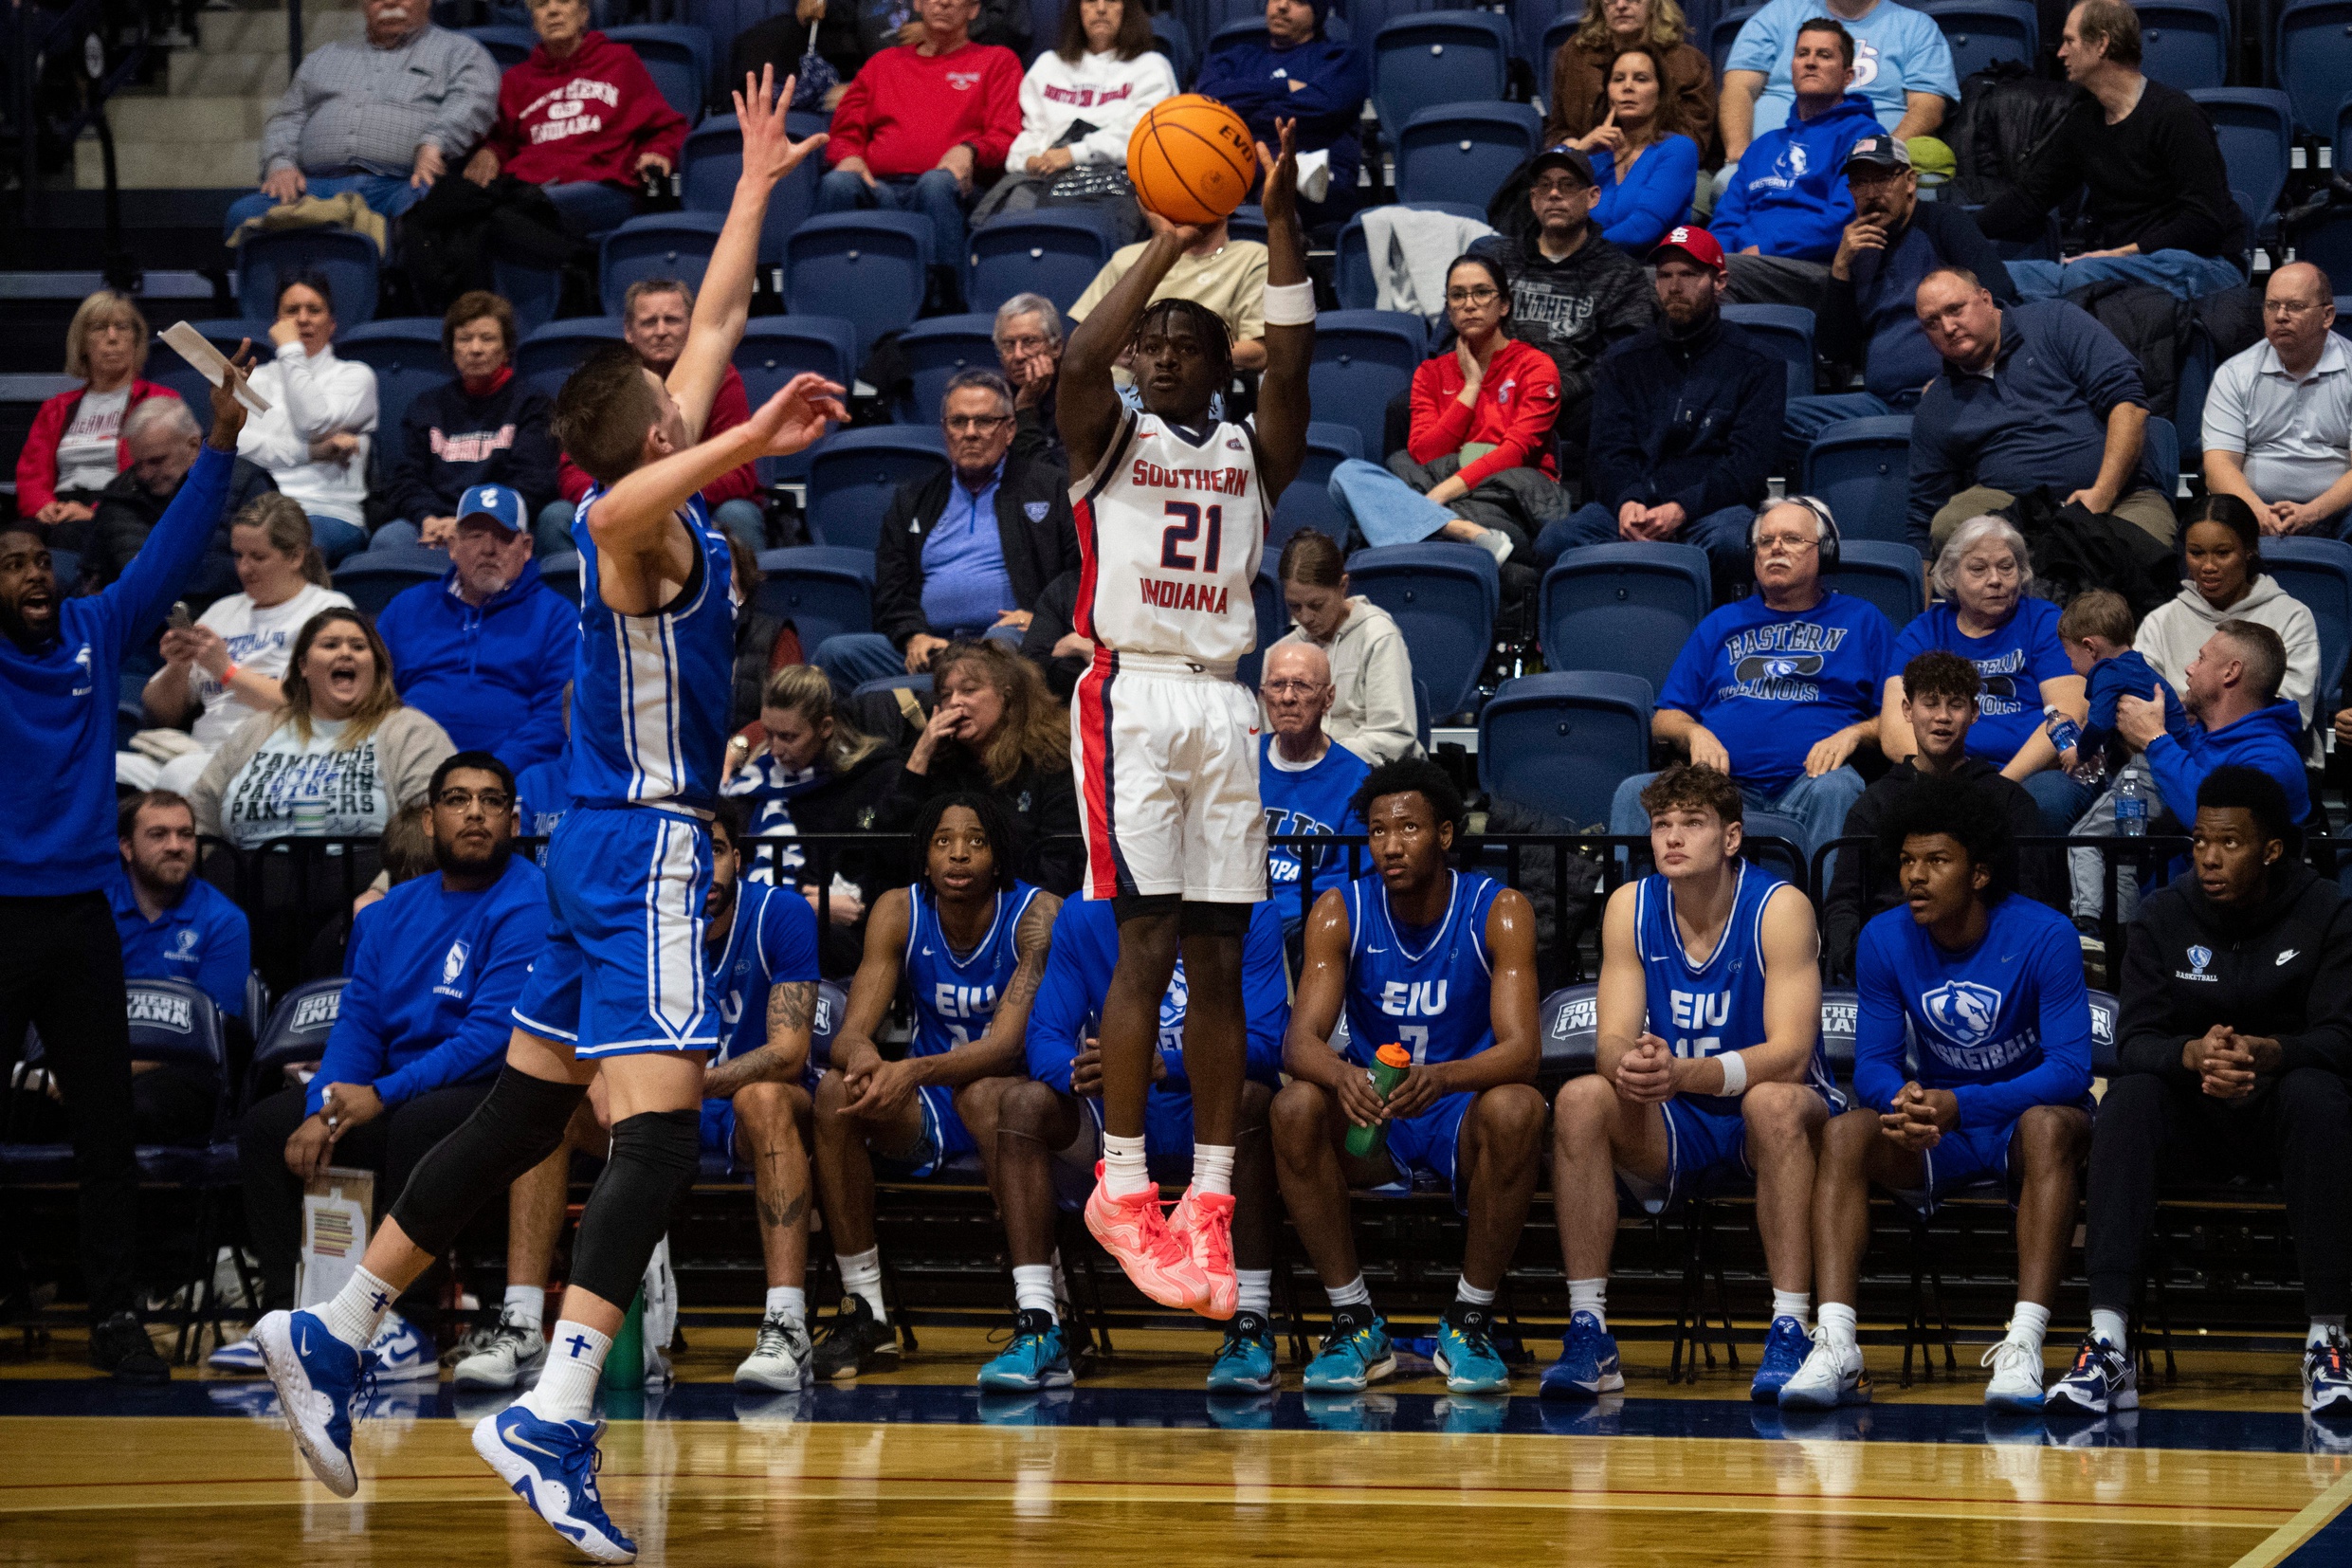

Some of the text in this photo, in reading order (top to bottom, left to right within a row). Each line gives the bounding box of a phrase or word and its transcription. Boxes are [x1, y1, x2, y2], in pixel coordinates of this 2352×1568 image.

[1749, 176, 1788, 191] EASTERN
[1132, 459, 1249, 498] SOUTHERN
[1160, 500, 1223, 574] 21
[1140, 577, 1229, 615] INDIANA
[1725, 620, 1848, 665] EASTERN
[1718, 676, 1819, 702] ILLINOIS
[2175, 970, 2218, 982] BASKETBALL
[936, 982, 997, 1018] EIU
[1379, 979, 1448, 1016] EIU
[1669, 990, 1731, 1030] EIU
[1398, 1025, 1430, 1067] 7
